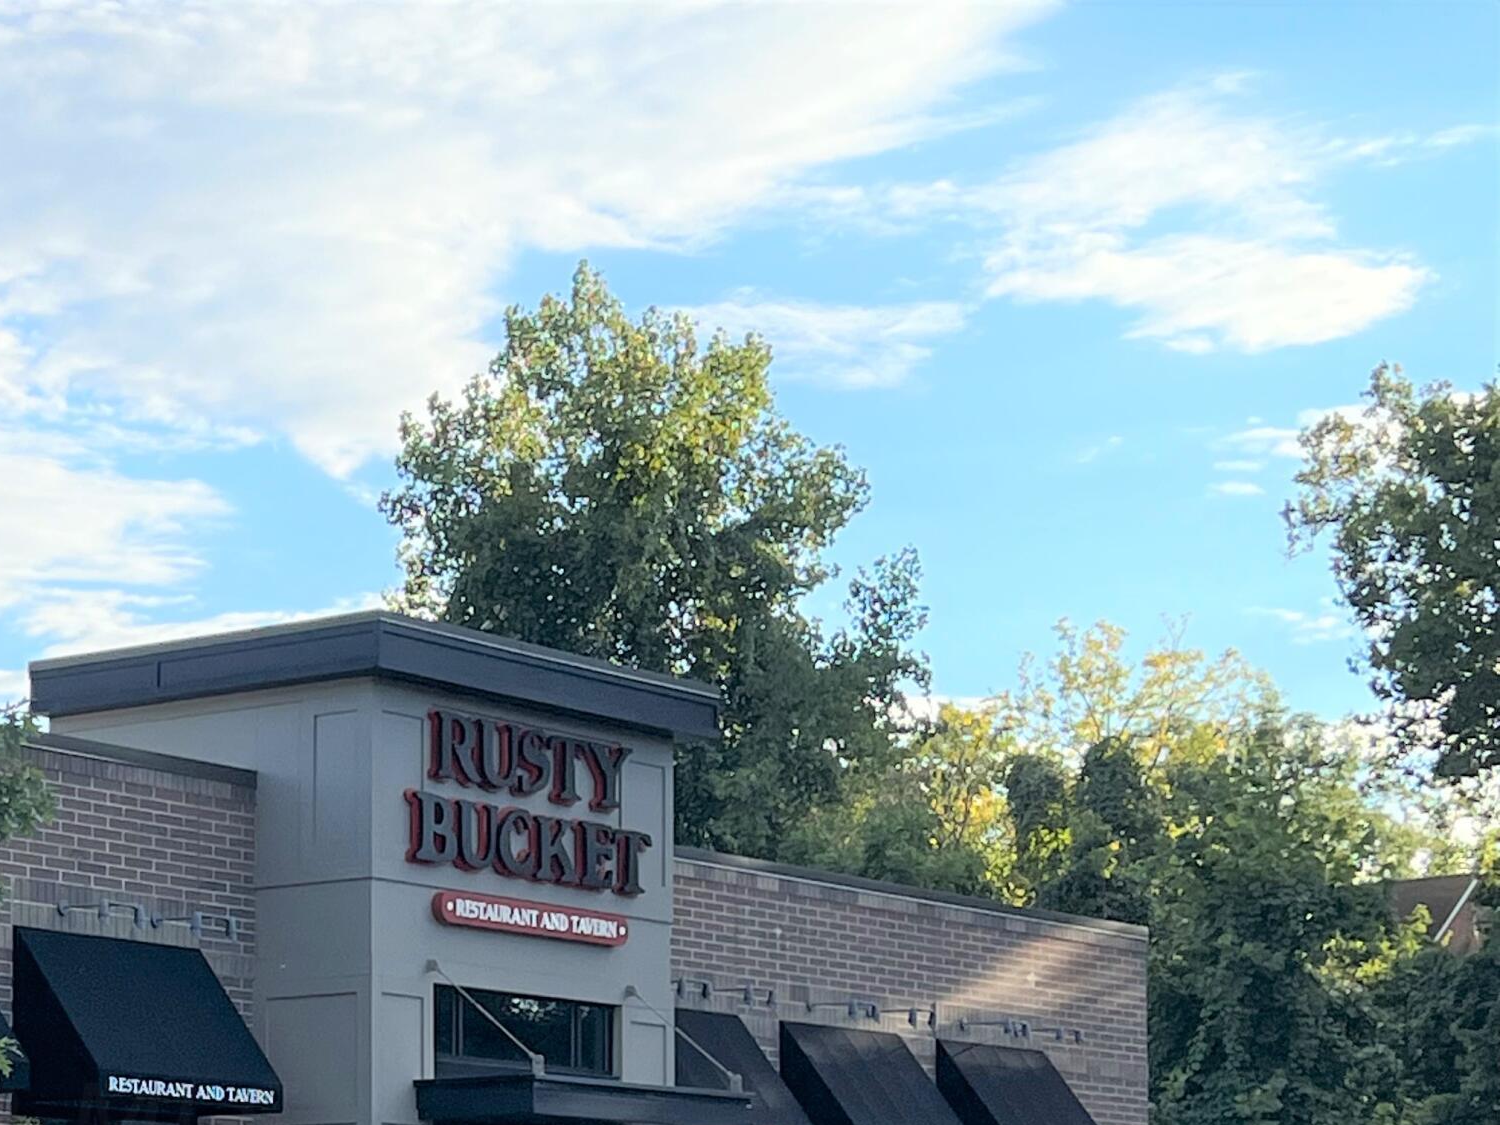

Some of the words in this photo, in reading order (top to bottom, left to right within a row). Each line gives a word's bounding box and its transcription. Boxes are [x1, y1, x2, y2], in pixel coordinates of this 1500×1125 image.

[427, 708, 632, 813] RUSTY
[403, 788, 652, 897] BUCKET
[455, 898, 539, 928] RESTAURANT
[540, 911, 569, 932] AND
[570, 915, 618, 939] TAVERN
[108, 1076, 194, 1098] RESTAURANT
[195, 1085, 225, 1101] AND
[226, 1086, 274, 1105] TAVERN
